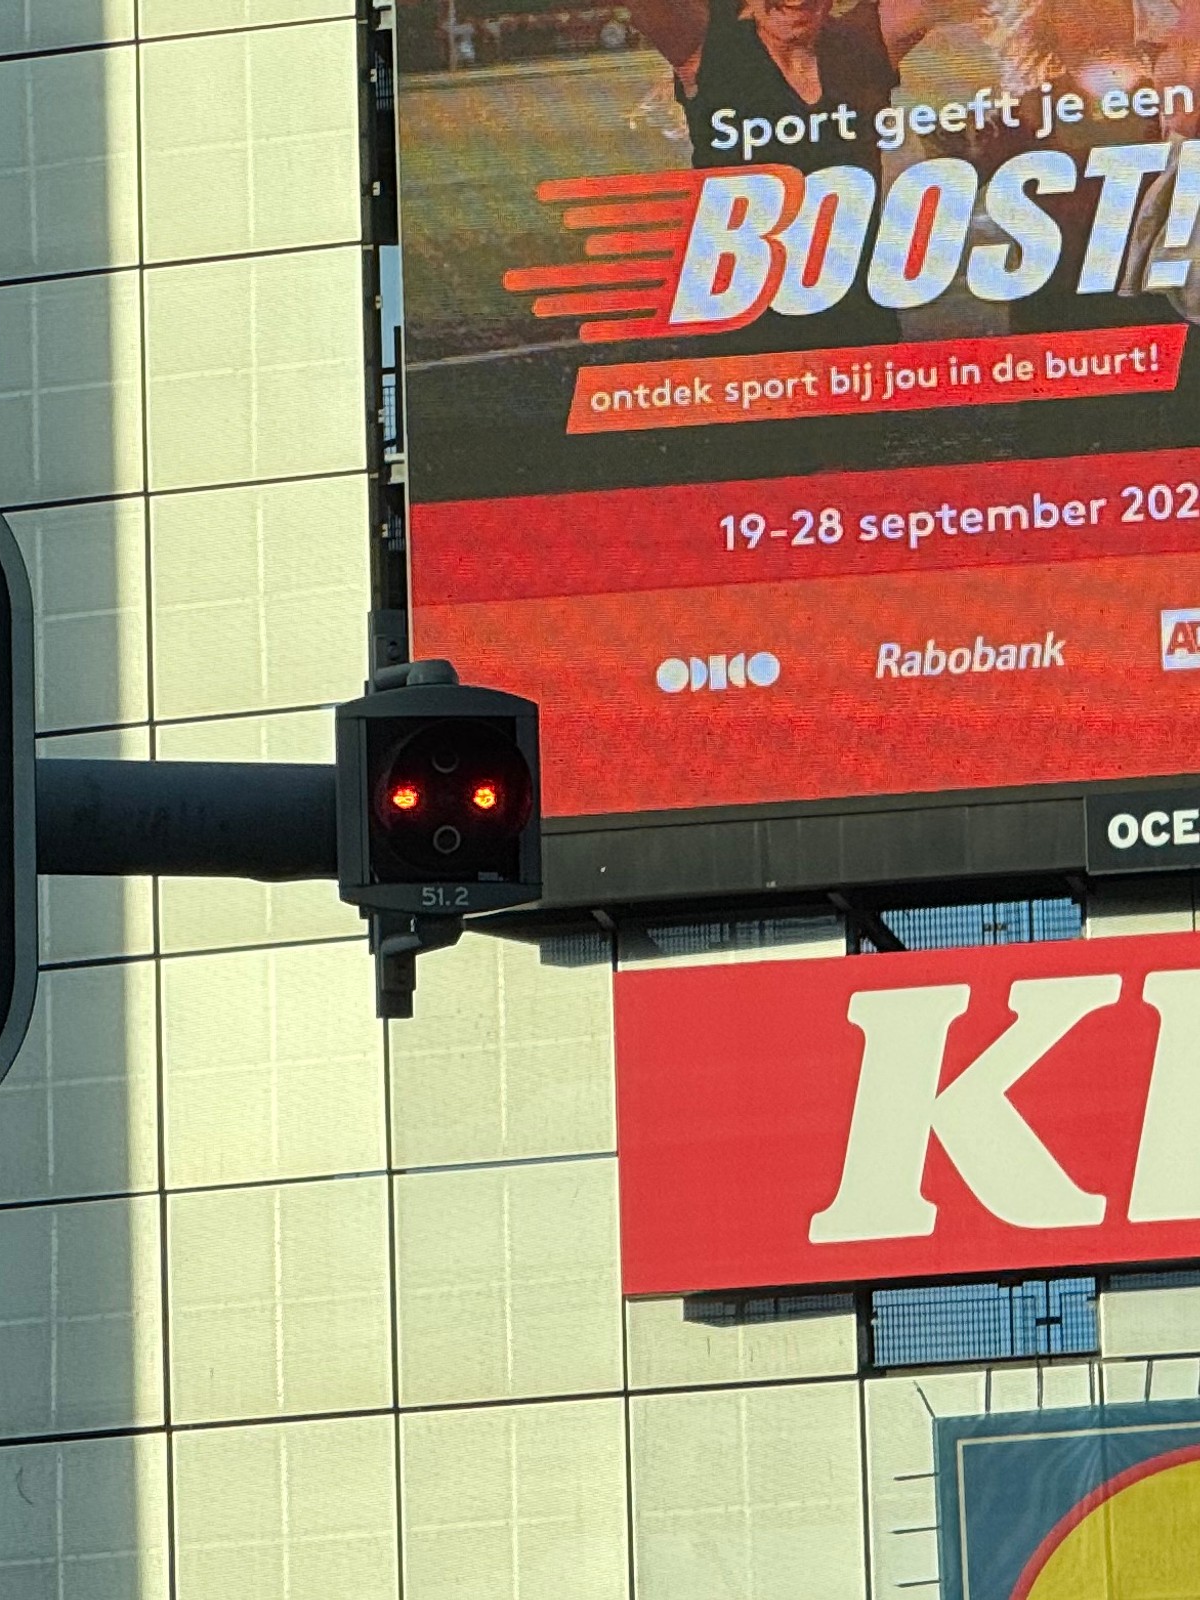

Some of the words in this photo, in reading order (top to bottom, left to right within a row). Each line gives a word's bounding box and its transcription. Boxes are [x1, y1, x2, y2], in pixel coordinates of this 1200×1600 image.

[710, 103, 858, 160] Sport
[873, 87, 1020, 149] geeft
[1035, 83, 1084, 138] je
[1101, 83, 1192, 118] een
[669, 140, 1200, 324] BOOST!
[590, 377, 712, 412] ontdek
[723, 371, 817, 409] sport
[829, 360, 874, 400] bij
[882, 360, 938, 399] jou
[949, 356, 982, 386] in
[991, 353, 1035, 383] de
[1045, 343, 1160, 379] buurt!
[719, 507, 843, 551] 19-28
[858, 492, 1108, 549] september
[1120, 481, 1200, 523] 202
[875, 630, 1067, 679] Rabobank
[1107, 808, 1200, 849] OCE
[422, 886, 470, 907] 51.2
